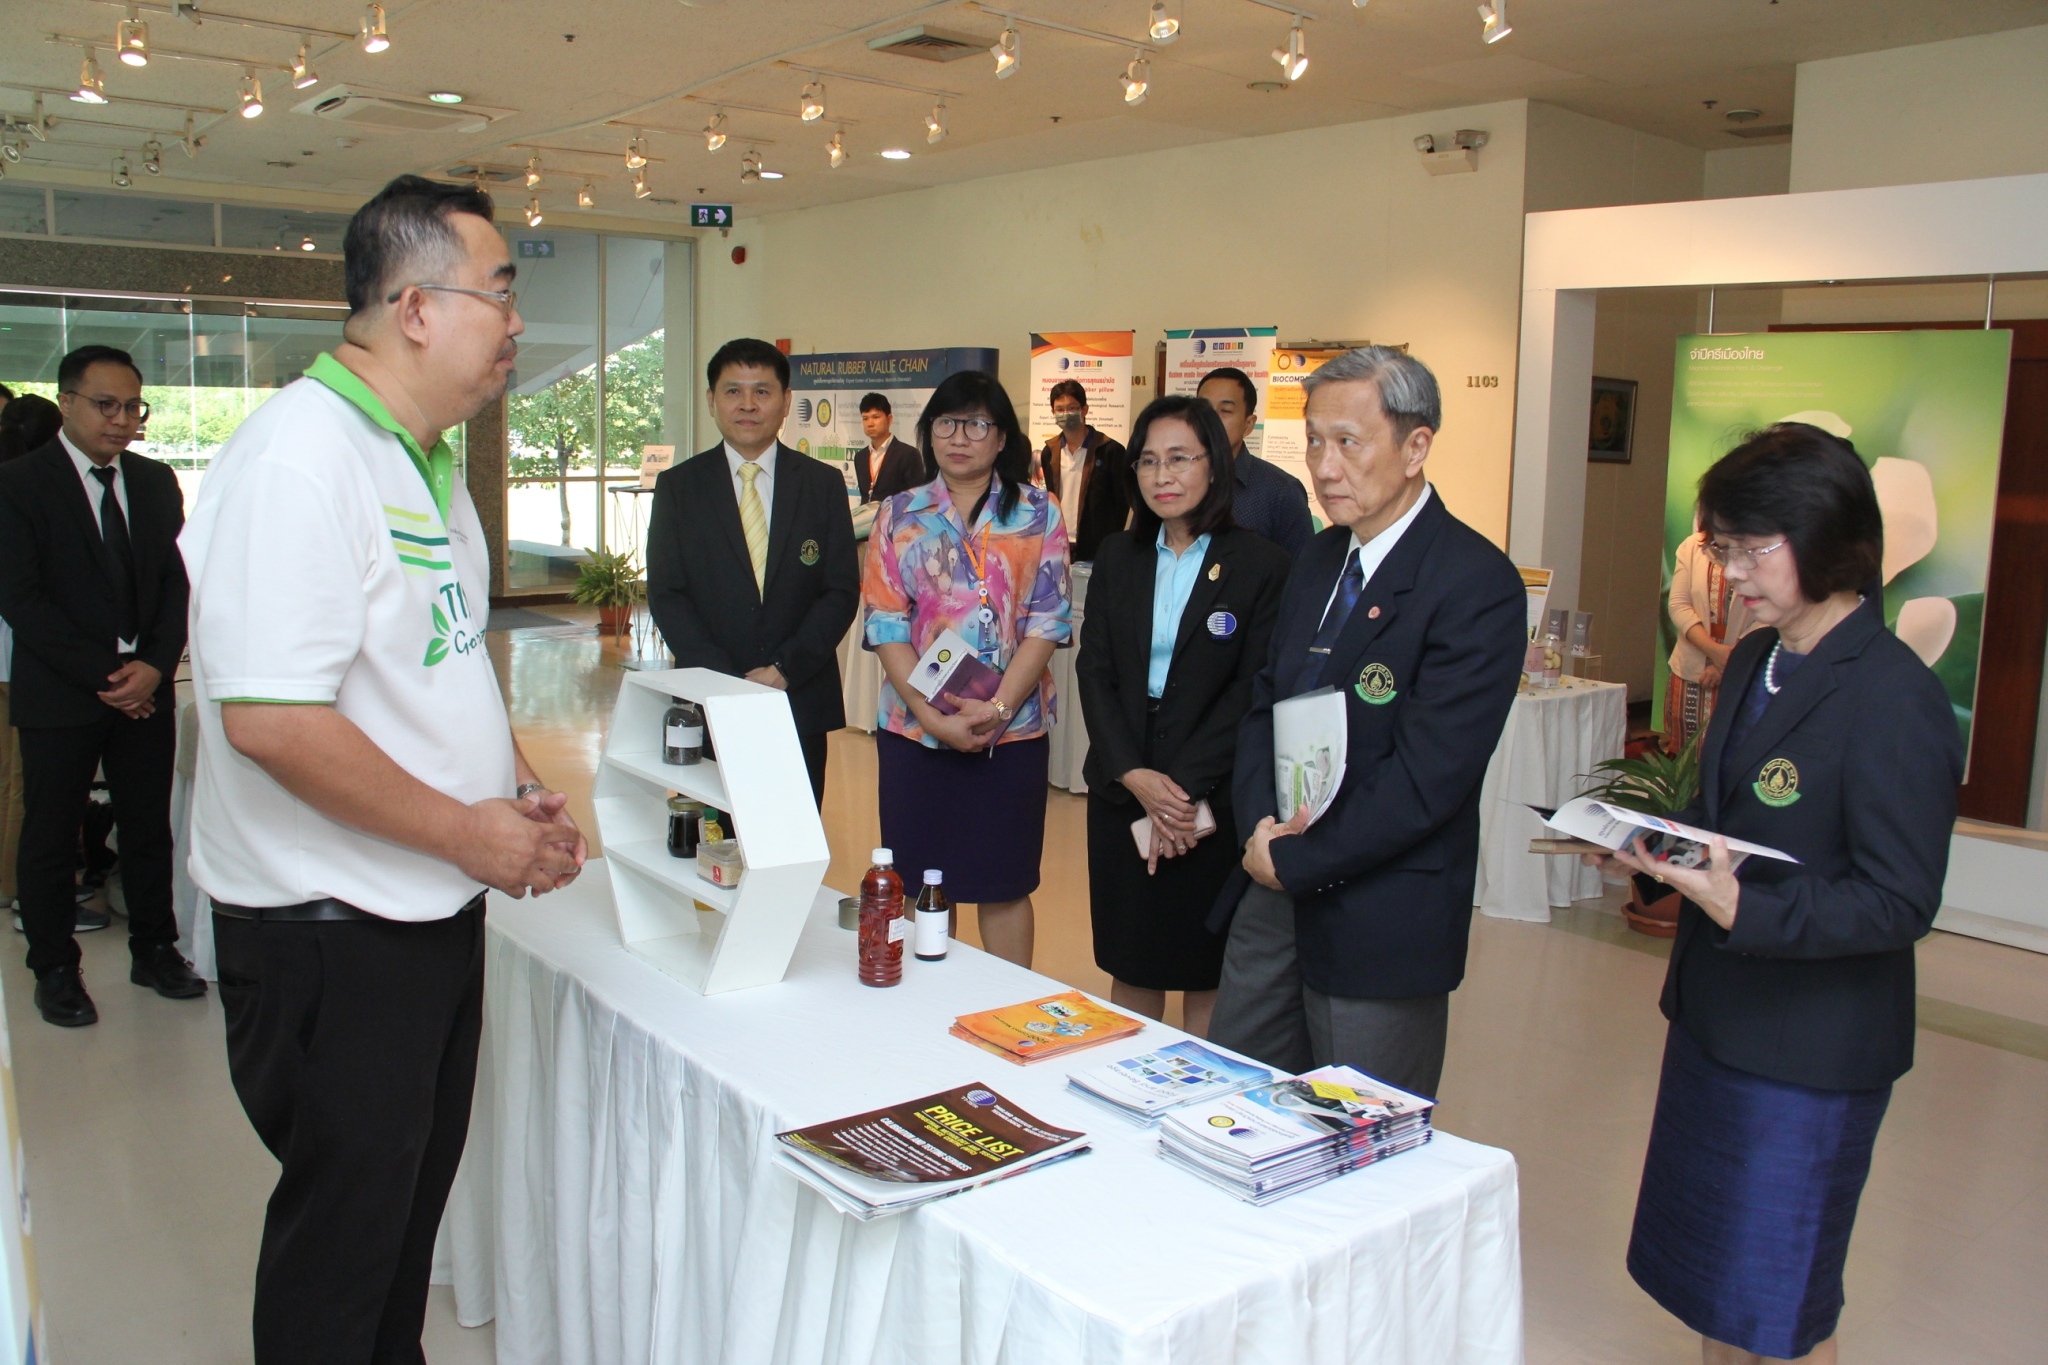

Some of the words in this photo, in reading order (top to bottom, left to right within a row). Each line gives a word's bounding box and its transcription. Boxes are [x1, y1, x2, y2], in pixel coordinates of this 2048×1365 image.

[800, 361, 836, 376] NATURAL
[838, 360, 867, 375] RUBBER
[870, 359, 897, 373] VALUE
[898, 358, 929, 373] CHAIN
[1272, 375, 1307, 383] BIOCOMP
[1466, 375, 1498, 388] 1103
[923, 1104, 983, 1138] PRICE
[974, 1136, 1025, 1157] LIST
